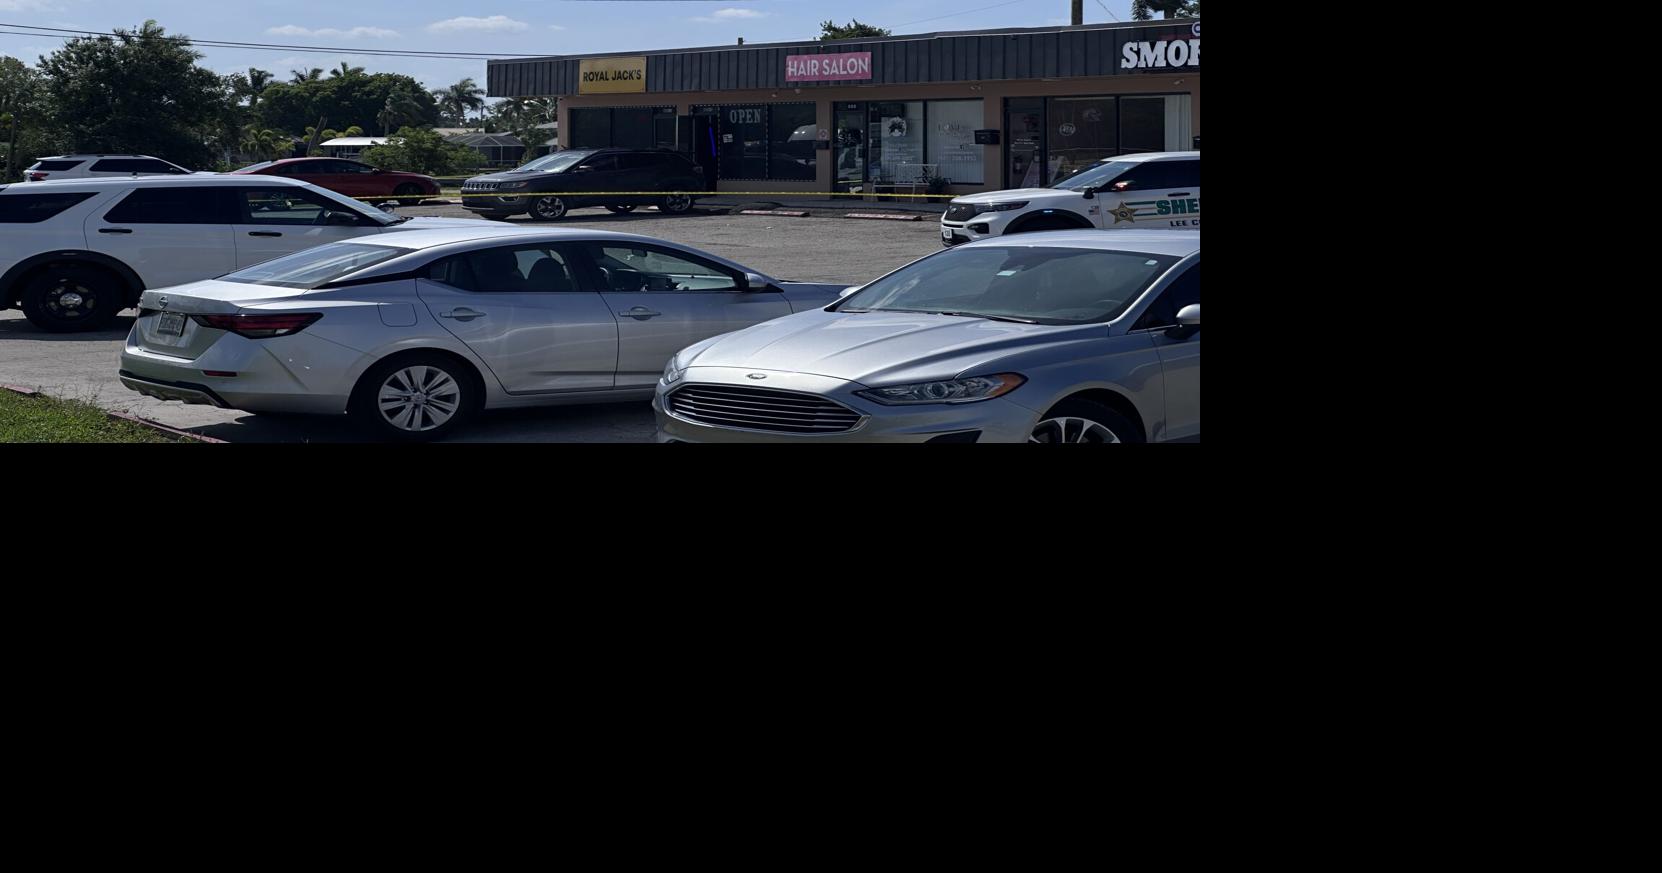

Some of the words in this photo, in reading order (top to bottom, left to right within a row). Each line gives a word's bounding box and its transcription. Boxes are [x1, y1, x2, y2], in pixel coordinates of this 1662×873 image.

[583, 69, 609, 82] ROYAL
[611, 68, 642, 81] JACK'S
[787, 60, 819, 77] HAIR
[822, 57, 869, 75] SALON
[729, 108, 761, 124] OPEN
[1156, 199, 1200, 215] SHE
